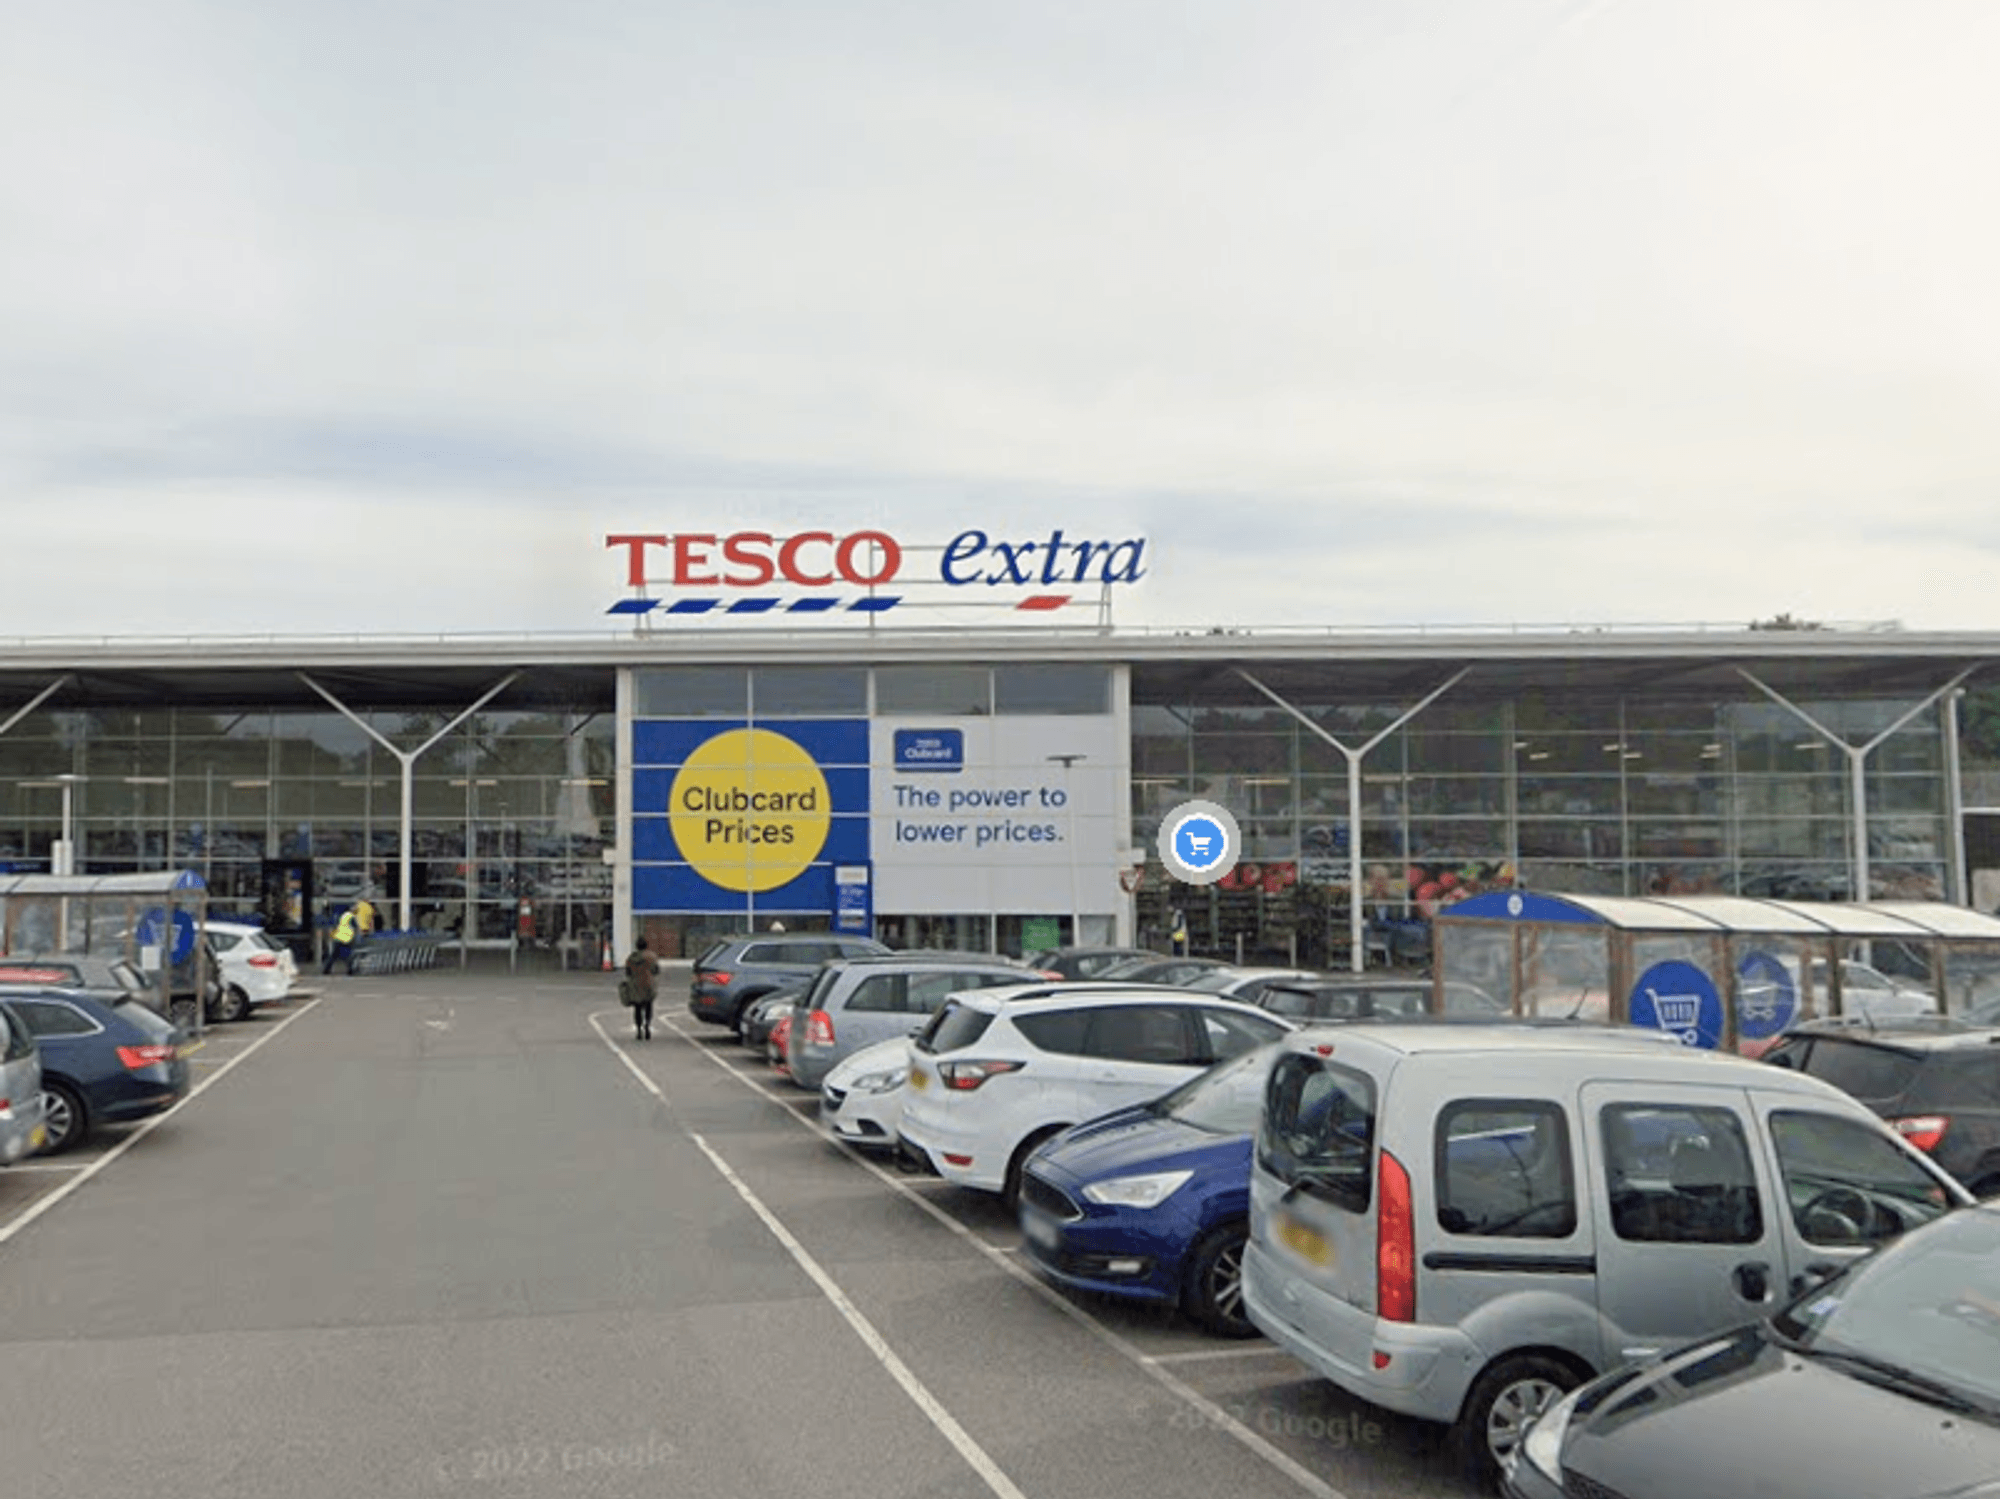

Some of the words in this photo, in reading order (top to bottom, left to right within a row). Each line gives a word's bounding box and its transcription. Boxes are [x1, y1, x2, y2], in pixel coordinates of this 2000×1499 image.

[606, 531, 902, 587] TESCO
[940, 529, 1147, 586] extra
[682, 786, 817, 812] Clubcard
[893, 784, 940, 807] The
[949, 788, 1032, 813] power
[1039, 786, 1067, 807] to
[706, 818, 794, 844] Prices
[896, 819, 967, 842] lower
[975, 819, 1065, 848] prices.
